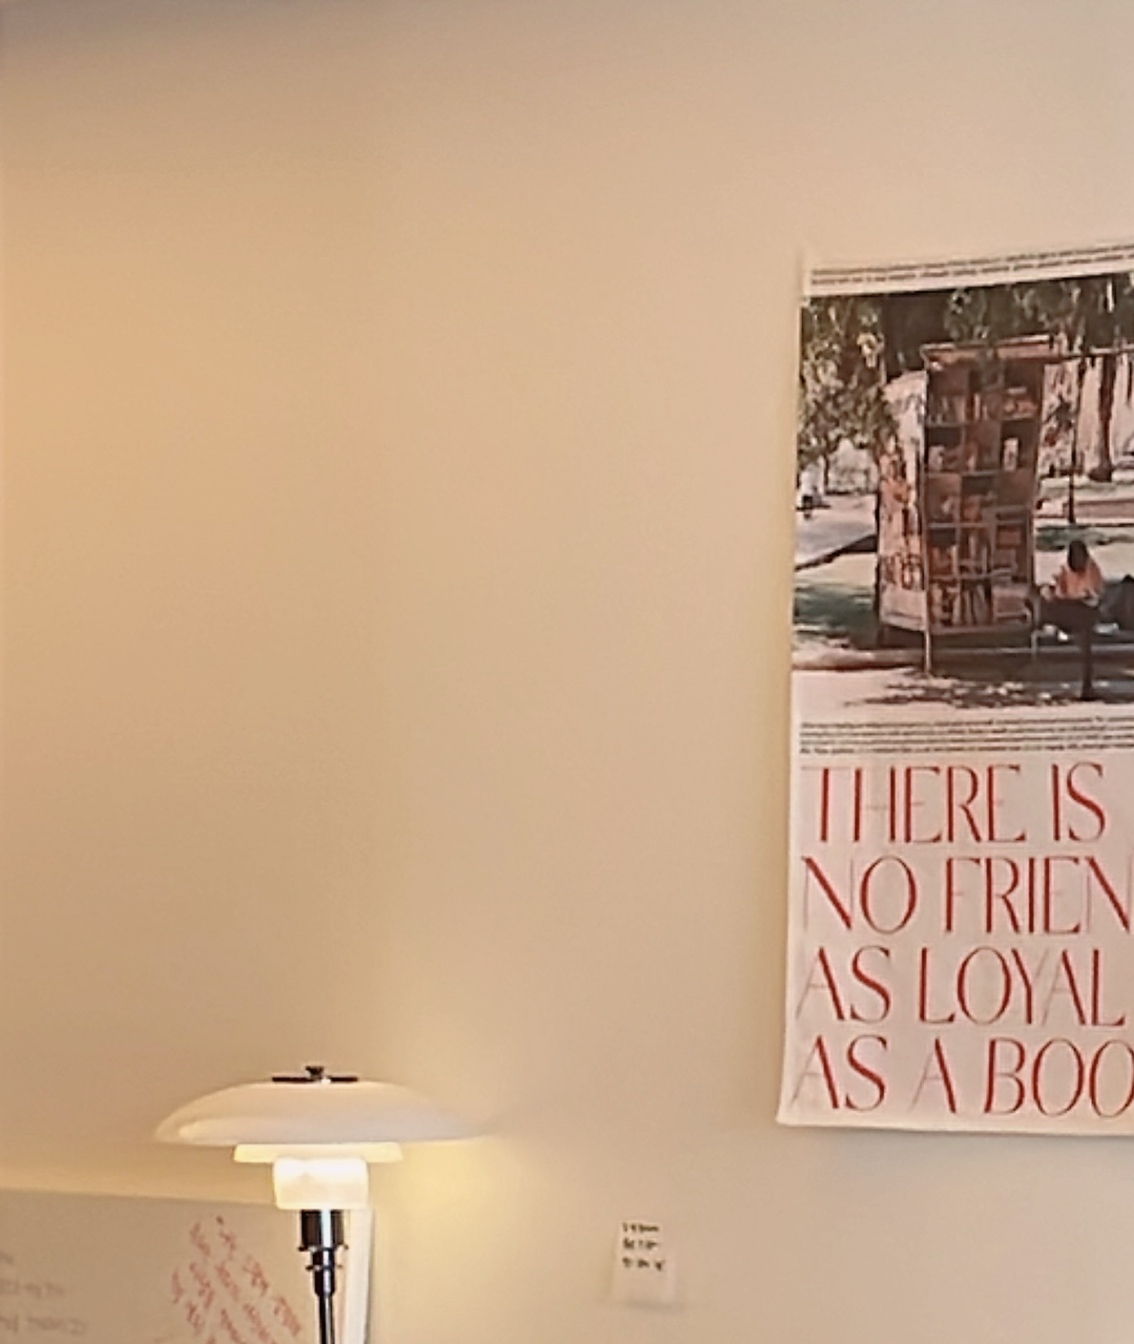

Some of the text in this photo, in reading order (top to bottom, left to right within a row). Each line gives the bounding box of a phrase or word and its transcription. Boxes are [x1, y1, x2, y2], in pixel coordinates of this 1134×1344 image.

[802, 760, 1106, 845] THERE IS
[800, 855, 917, 935] NO
[796, 944, 1127, 1027] AS LOYAL
[788, 1035, 888, 1114] AS
[911, 1035, 959, 1114] A
